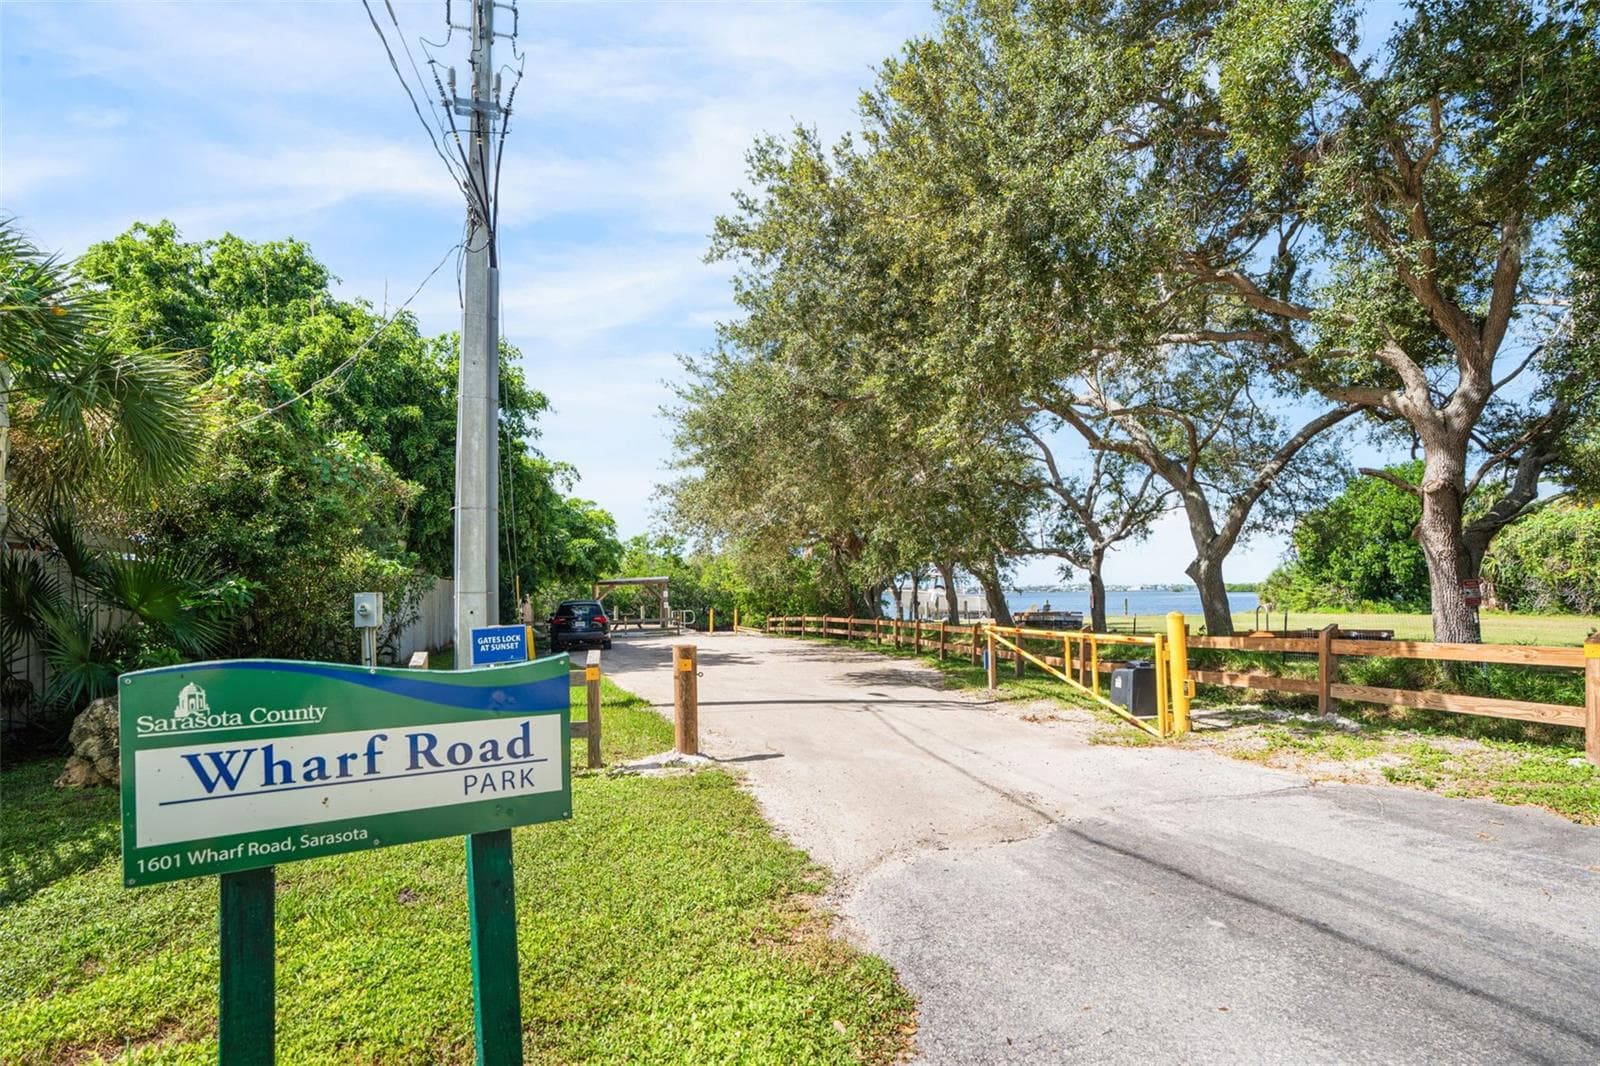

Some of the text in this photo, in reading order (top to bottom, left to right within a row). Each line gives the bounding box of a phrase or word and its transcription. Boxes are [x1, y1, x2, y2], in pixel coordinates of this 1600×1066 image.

[477, 634, 521, 645] GATES LOCK
[480, 642, 519, 652] AT SUNSET
[136, 704, 328, 733] Sarasota County
[181, 720, 535, 794] Wharf Road
[463, 767, 535, 796] PARK
[136, 828, 368, 873] 1601 Wharf Road, Sarasota
